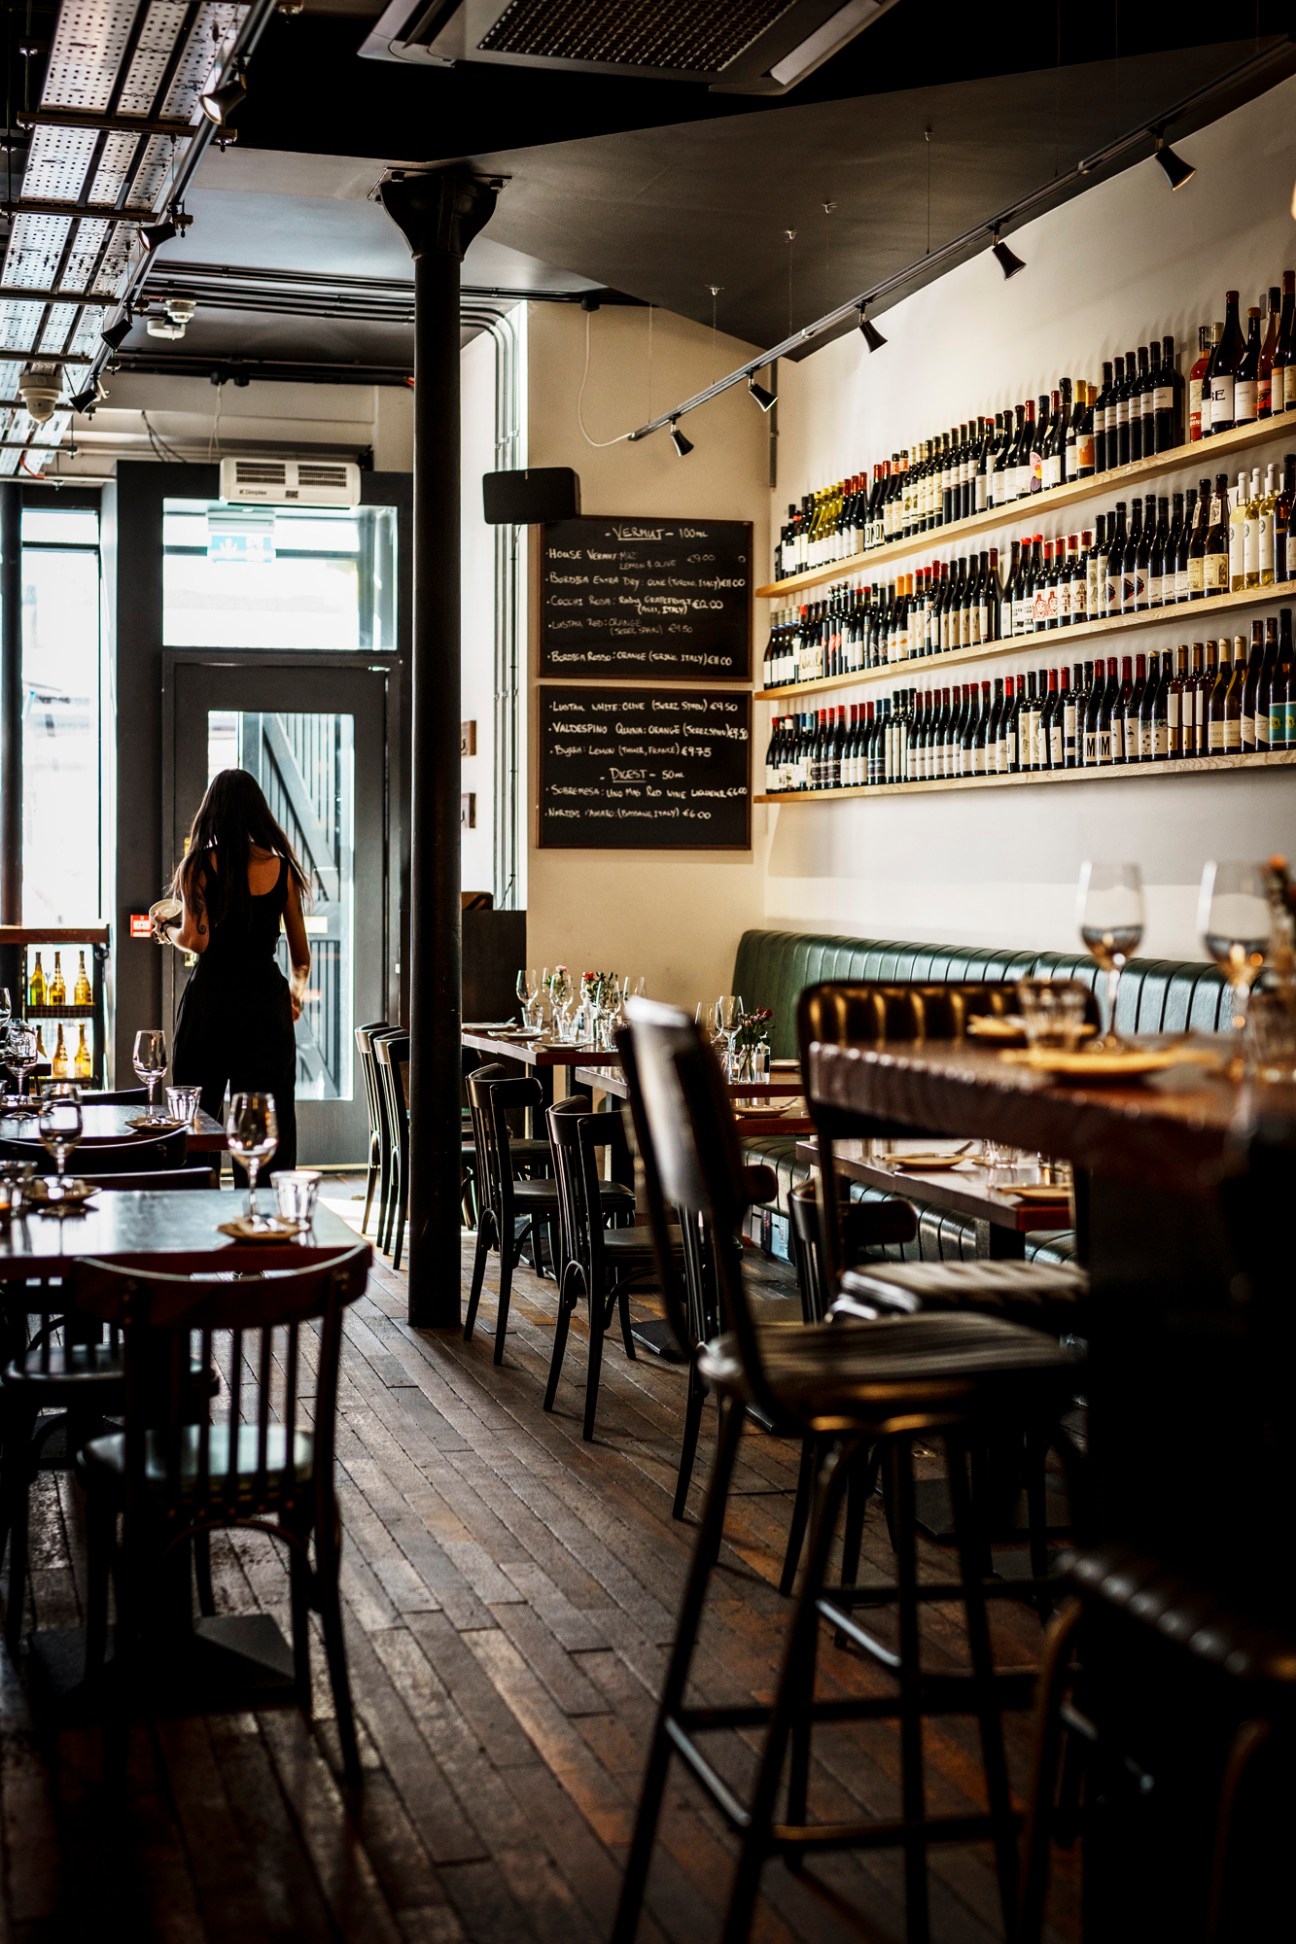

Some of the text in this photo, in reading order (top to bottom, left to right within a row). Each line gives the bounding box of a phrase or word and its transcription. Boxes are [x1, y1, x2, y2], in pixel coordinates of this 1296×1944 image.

[612, 525, 665, 540] VERMUT
[549, 548, 582, 559] HOUSE
[616, 651, 646, 661] ORANGE
[552, 721, 608, 734] VALDESPINO
[648, 725, 680, 735] ORANGE
[589, 745, 615, 755] LEMON
[666, 790, 686, 799] WINE
